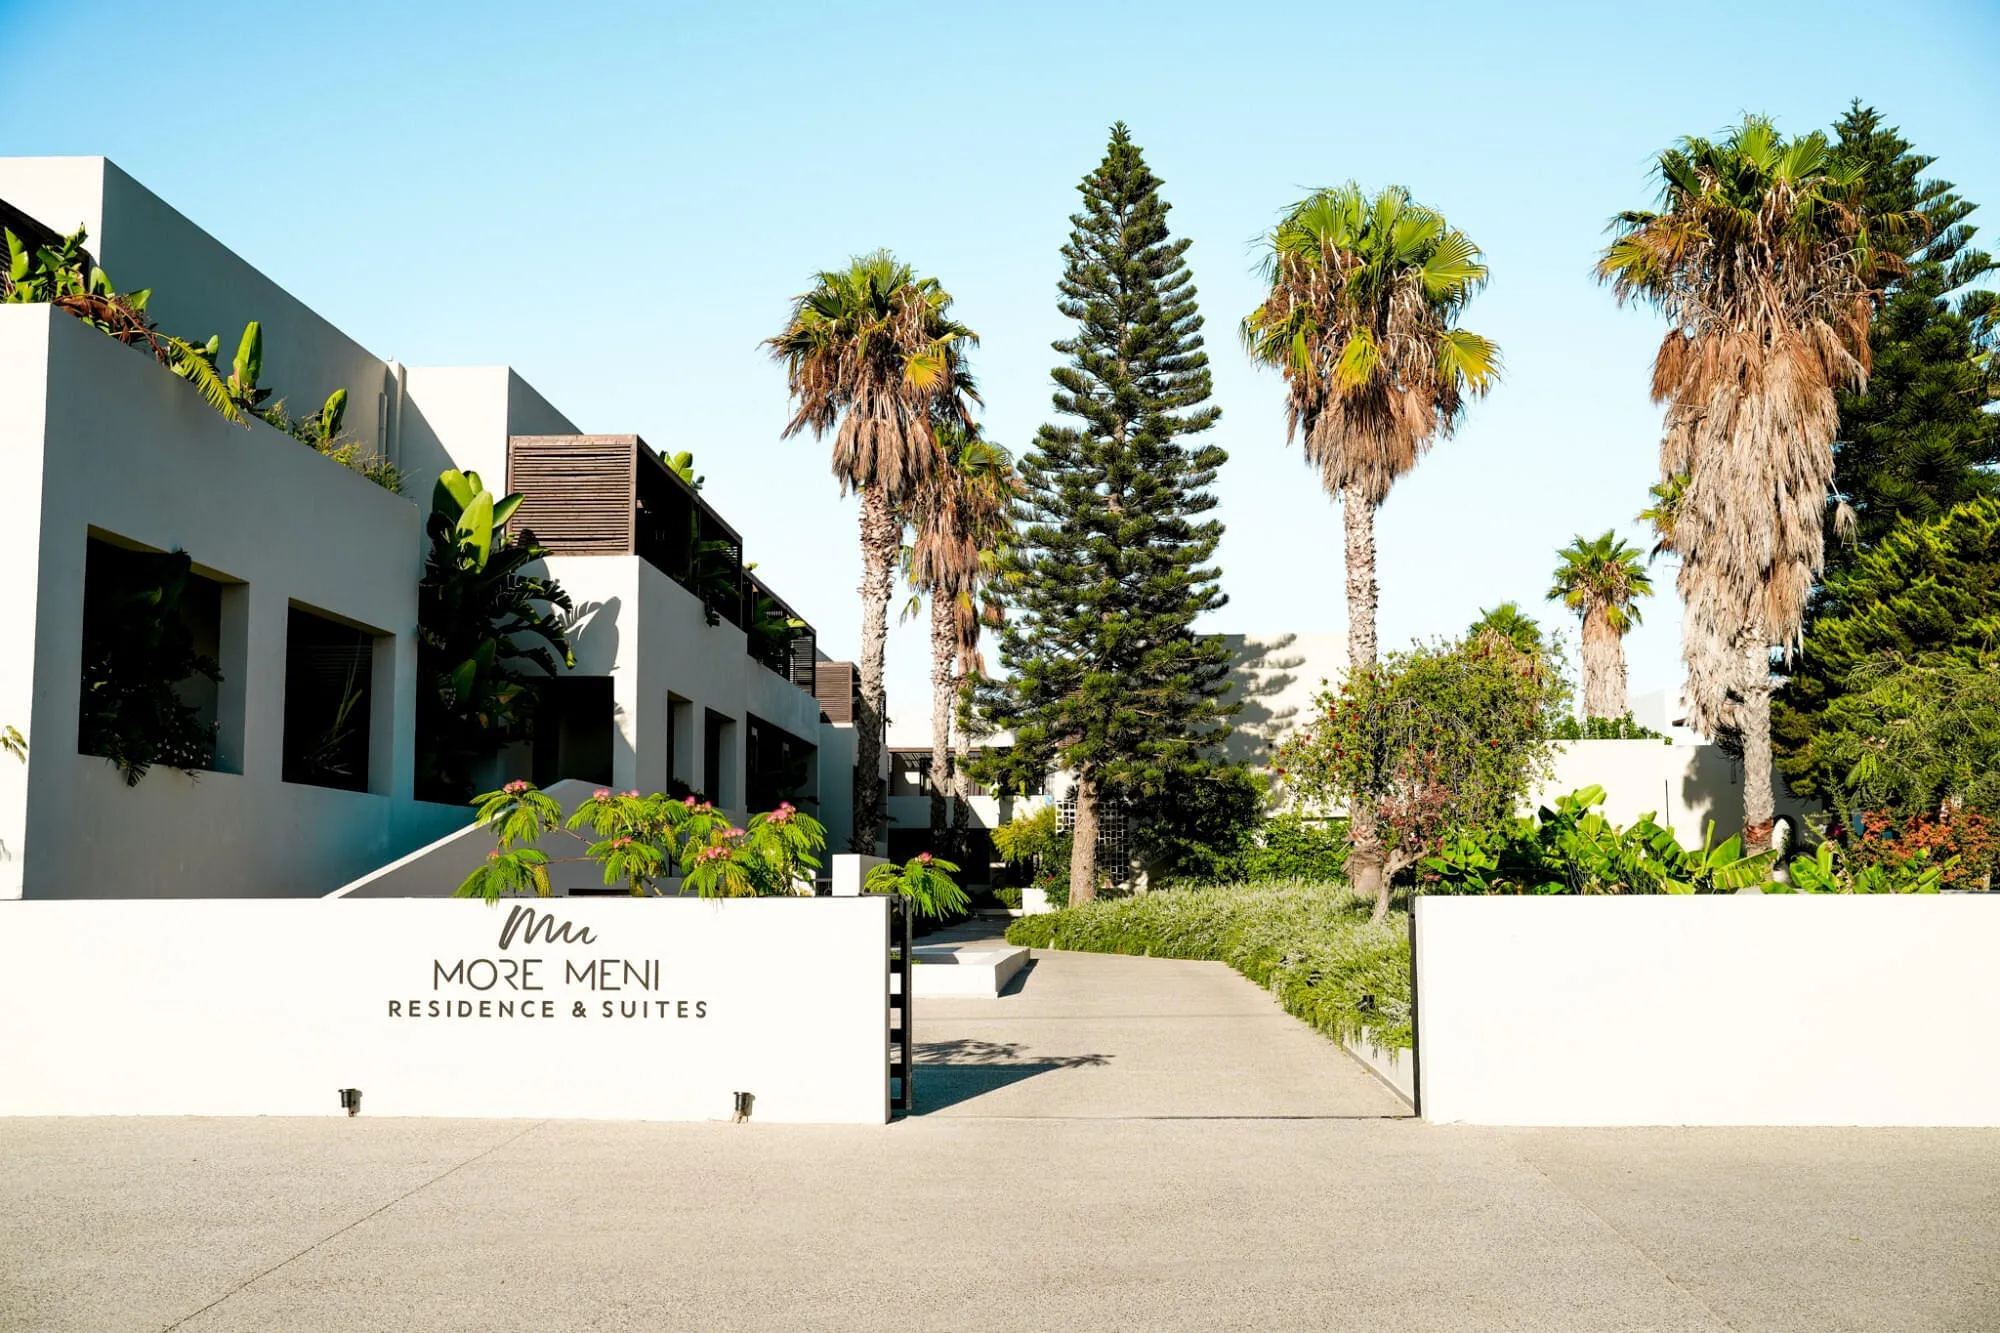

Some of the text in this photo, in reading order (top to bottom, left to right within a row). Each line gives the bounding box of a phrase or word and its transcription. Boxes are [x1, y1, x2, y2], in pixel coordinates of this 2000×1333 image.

[433, 958, 659, 991] MORE MENI
[388, 1000, 707, 1019] RESIDENCE & SUITES
